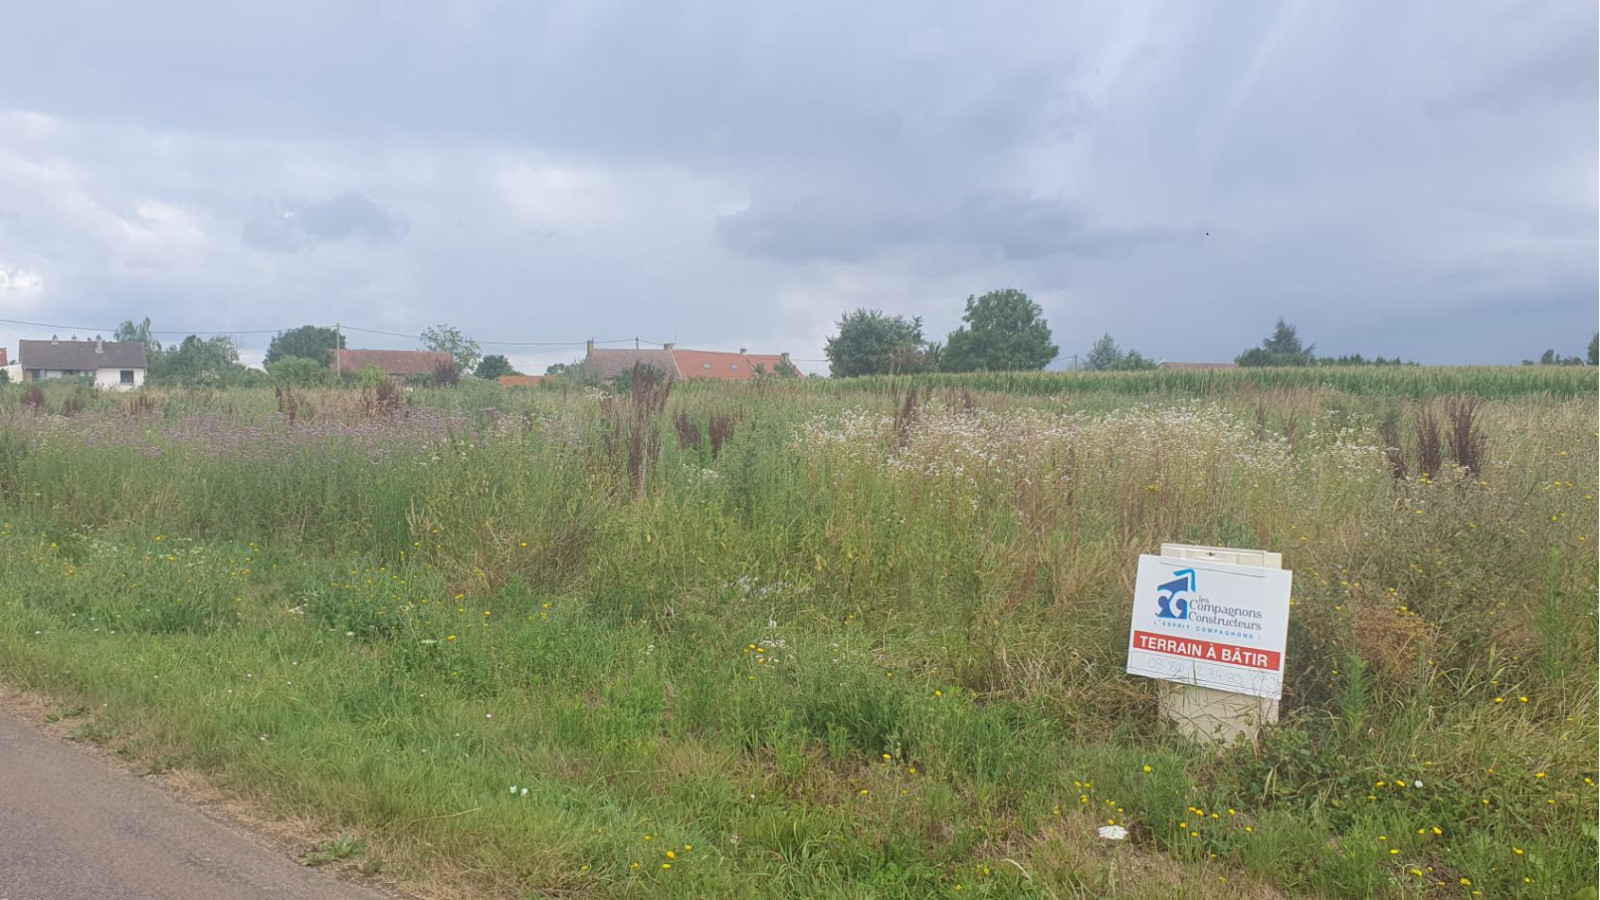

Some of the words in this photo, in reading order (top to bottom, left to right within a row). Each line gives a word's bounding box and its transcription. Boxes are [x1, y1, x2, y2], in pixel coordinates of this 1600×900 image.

[1189, 599, 1262, 619] Compagnons
[1198, 595, 1210, 603] les
[1153, 619, 1191, 630] L'ESPRIT
[1196, 626, 1254, 640] COMPAGNONS
[1188, 611, 1262, 631] Constructeurs
[1140, 635, 1202, 657] TERRAIN
[1206, 644, 1217, 659] À
[1221, 647, 1268, 667] BÂTIR
